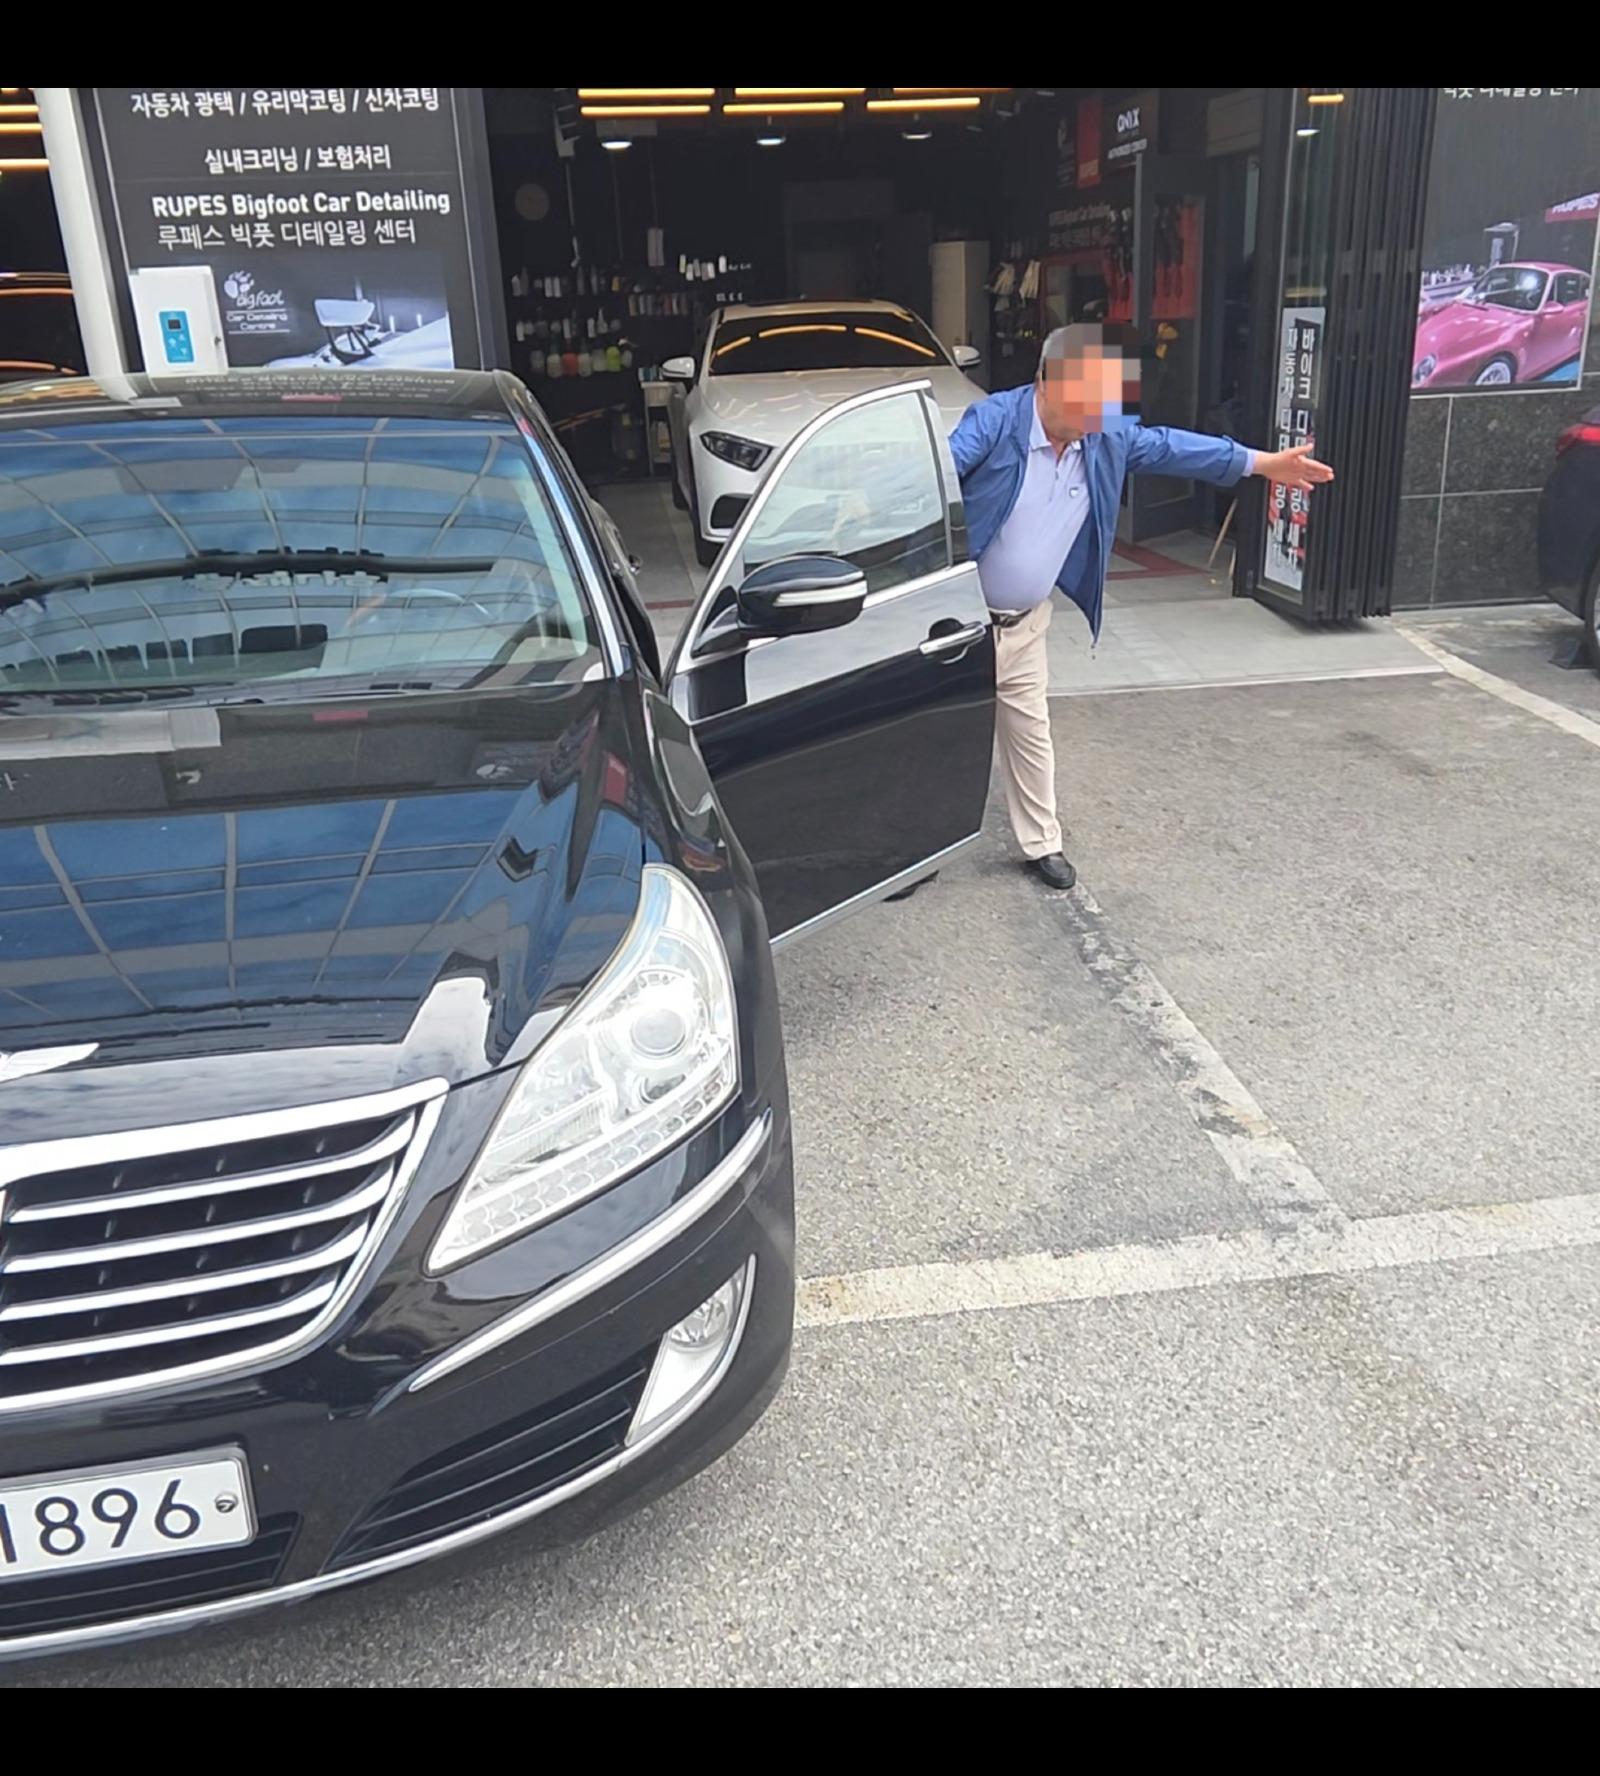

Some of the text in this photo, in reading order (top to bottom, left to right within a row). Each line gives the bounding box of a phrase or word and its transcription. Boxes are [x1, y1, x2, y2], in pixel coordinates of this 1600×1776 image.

[131, 91, 190, 118] 자동차
[194, 90, 235, 117] 광택
[252, 88, 346, 116] 유리막코팅
[365, 88, 439, 112] 신차코팅
[204, 147, 298, 174] 실내크리닝
[317, 144, 391, 170] 보험처리
[152, 189, 450, 220] RUPES Bigfoot Car Detailing
[158, 218, 416, 251] 루페스 빅풋 디테일링 센터
[1284, 327, 1298, 400] 자동차
[1298, 328, 1315, 399] 바이크
[0, 1478, 202, 1564] 1896
